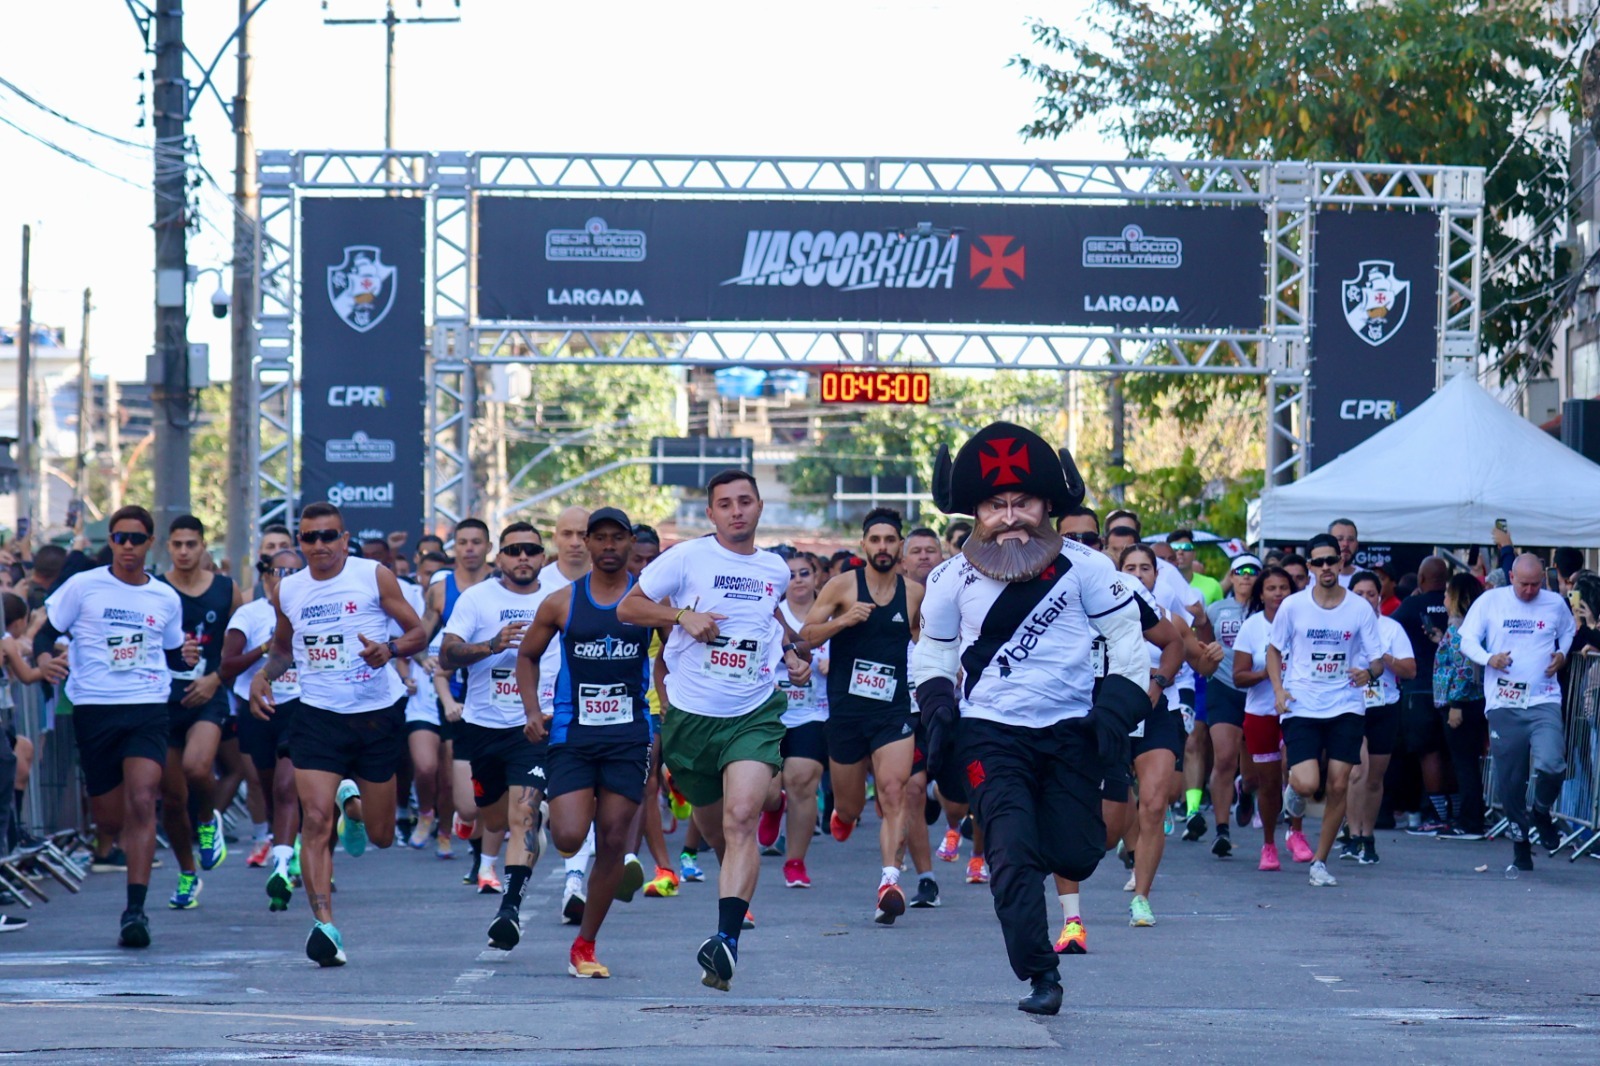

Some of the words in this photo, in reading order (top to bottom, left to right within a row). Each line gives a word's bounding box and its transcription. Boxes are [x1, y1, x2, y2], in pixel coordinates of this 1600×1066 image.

[551, 234, 591, 246] SEJA
[1087, 241, 1127, 252] SEJA
[1129, 241, 1178, 253] SÓCIO
[720, 230, 960, 291] VASCORRIDA
[1086, 253, 1178, 264] ESTATUTÁRIO
[547, 288, 645, 306] LARGADA
[1084, 295, 1180, 313] LARGADA
[328, 386, 380, 407] CPR
[822, 373, 929, 403] 00:45:00
[1340, 399, 1392, 420] CPR
[327, 482, 394, 508] genial
[713, 575, 763, 594] VASCORRIDA
[301, 602, 342, 620] VASCORRIDA
[1004, 591, 1068, 663] betfair
[112, 647, 137, 661] 2857
[308, 648, 337, 661] 5349
[710, 650, 747, 669] 5695
[1316, 663, 1338, 673] 4197
[495, 682, 520, 695] 304
[856, 673, 886, 689] 5430
[1499, 688, 1521, 700] 2427
[585, 700, 619, 713] 5302
